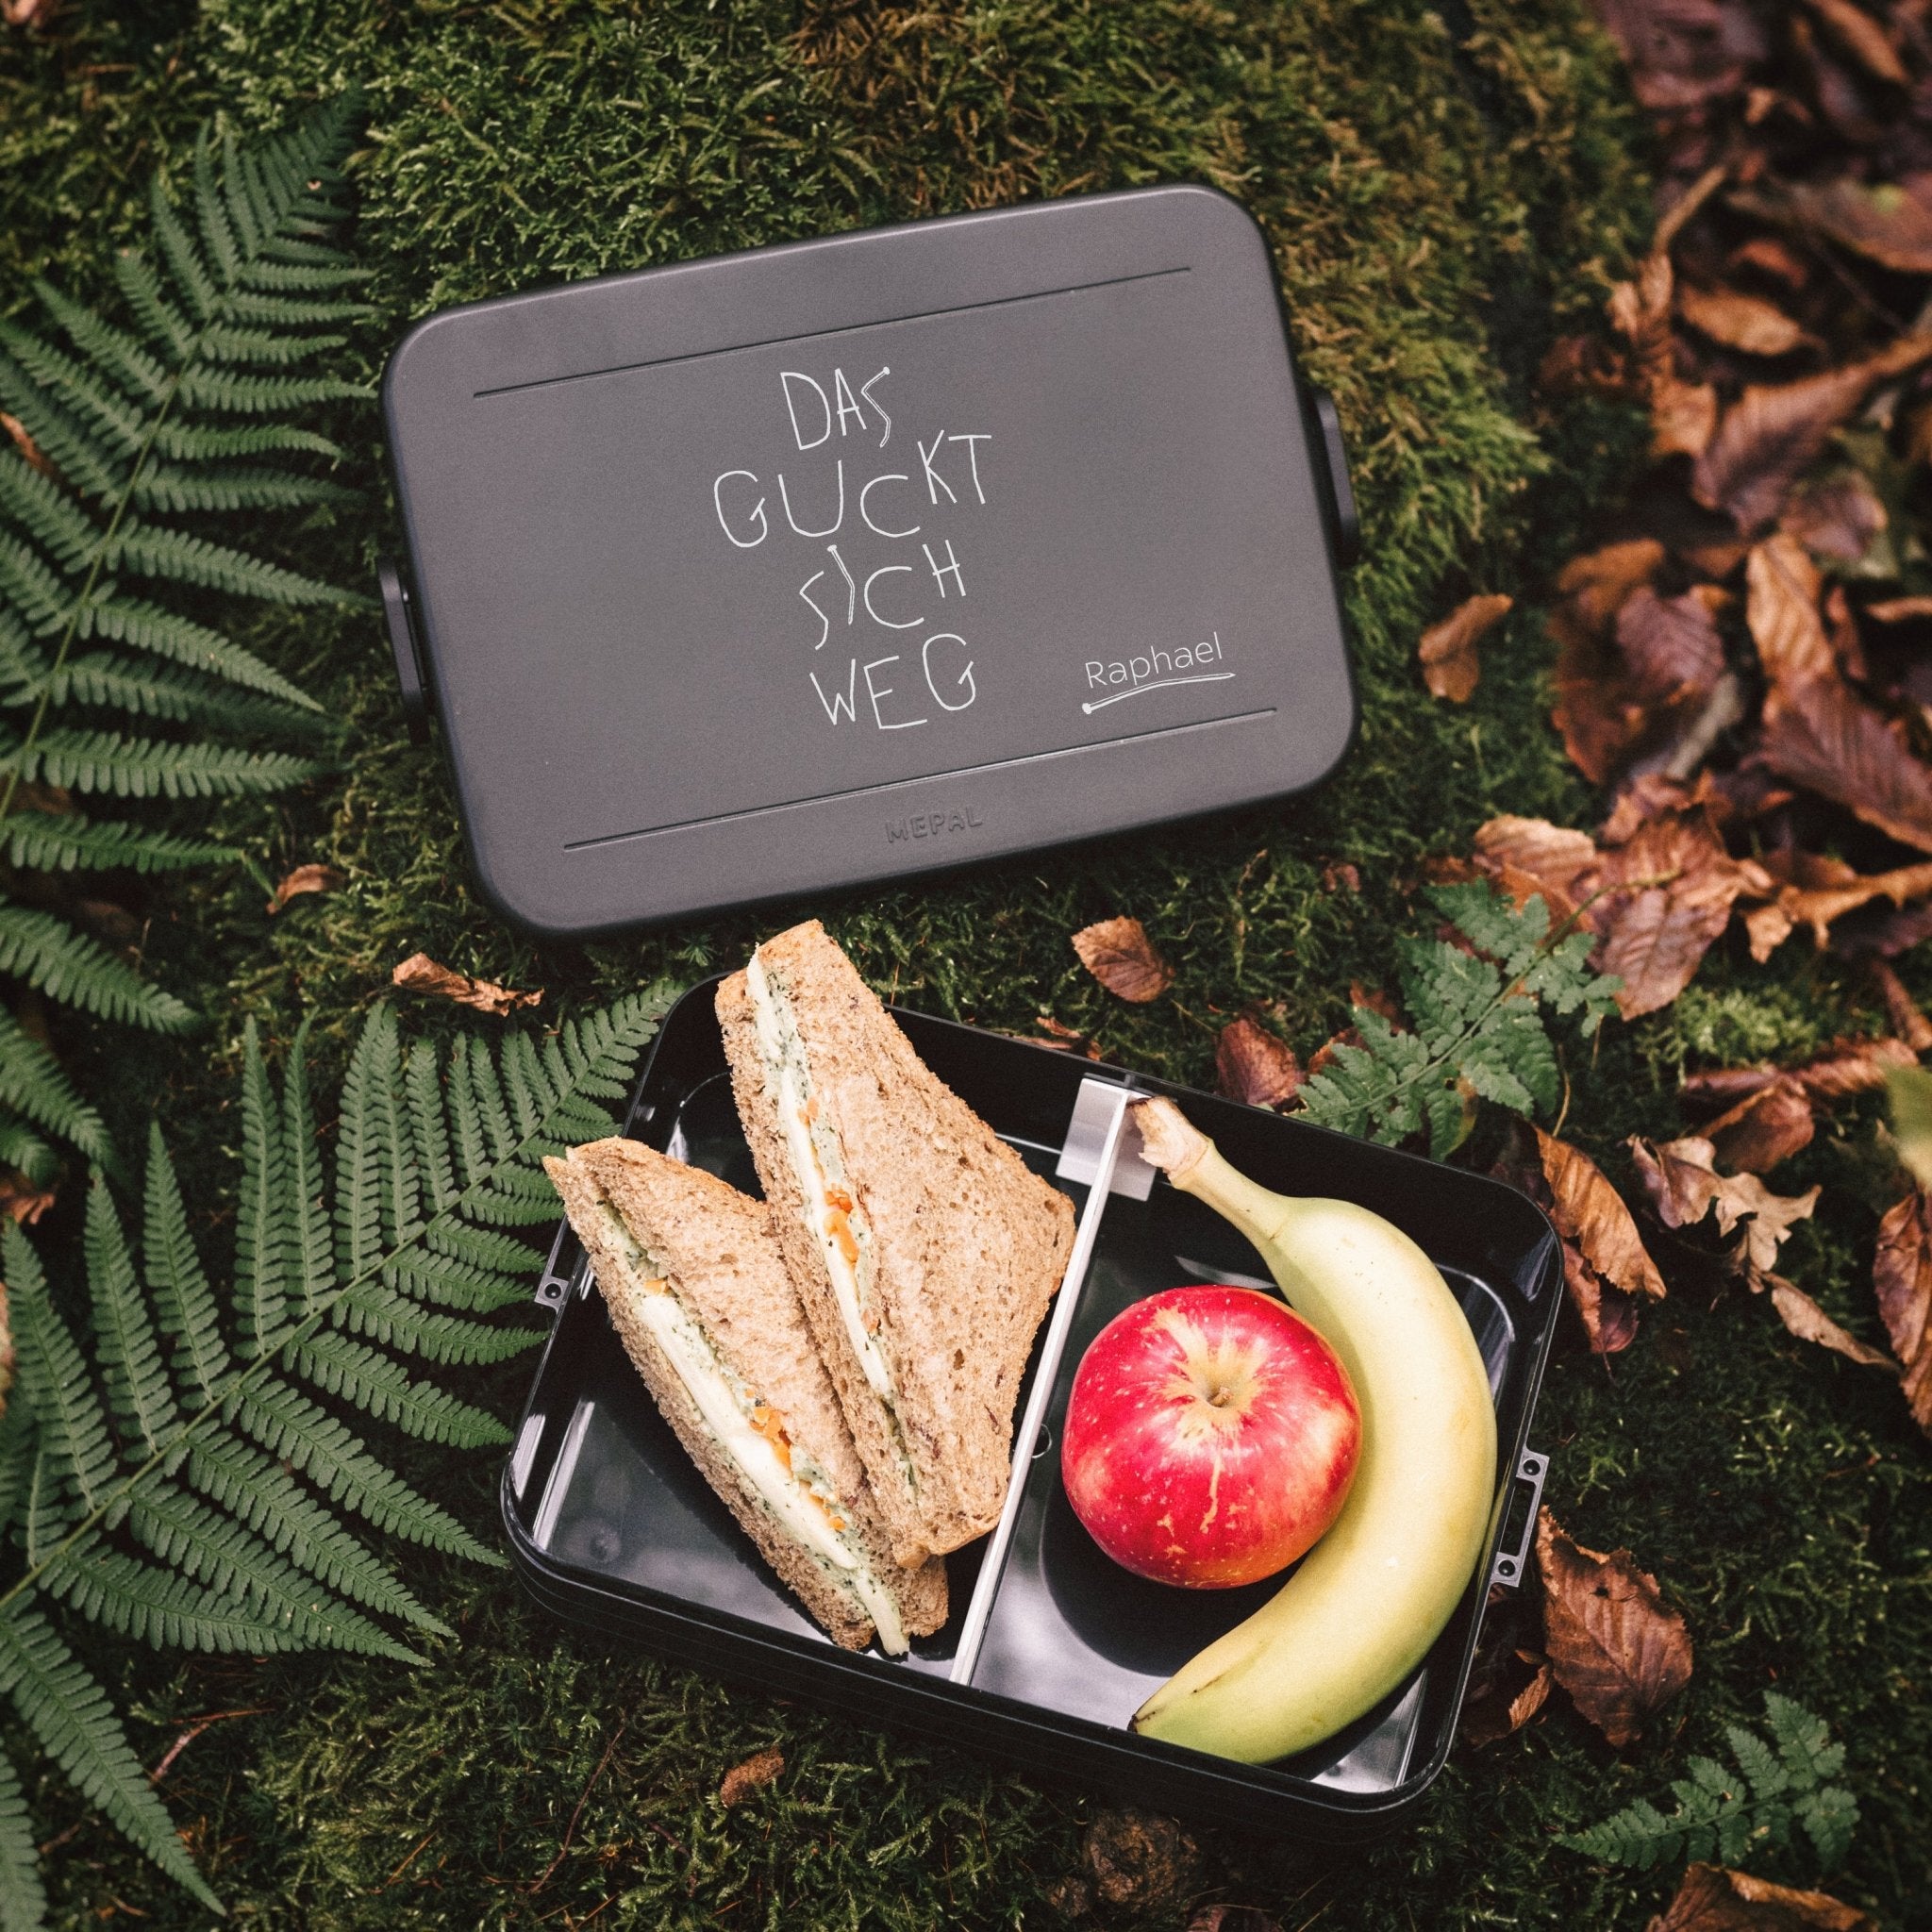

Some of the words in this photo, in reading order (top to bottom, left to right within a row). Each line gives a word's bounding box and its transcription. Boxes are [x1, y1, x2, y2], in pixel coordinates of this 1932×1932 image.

[779, 366, 891, 451] DAS
[713, 429, 992, 548] GUCKT
[798, 539, 967, 651] SICH
[808, 633, 976, 730] WEG
[1085, 631, 1223, 689] Raphael
[885, 807, 983, 843] MEPAL
